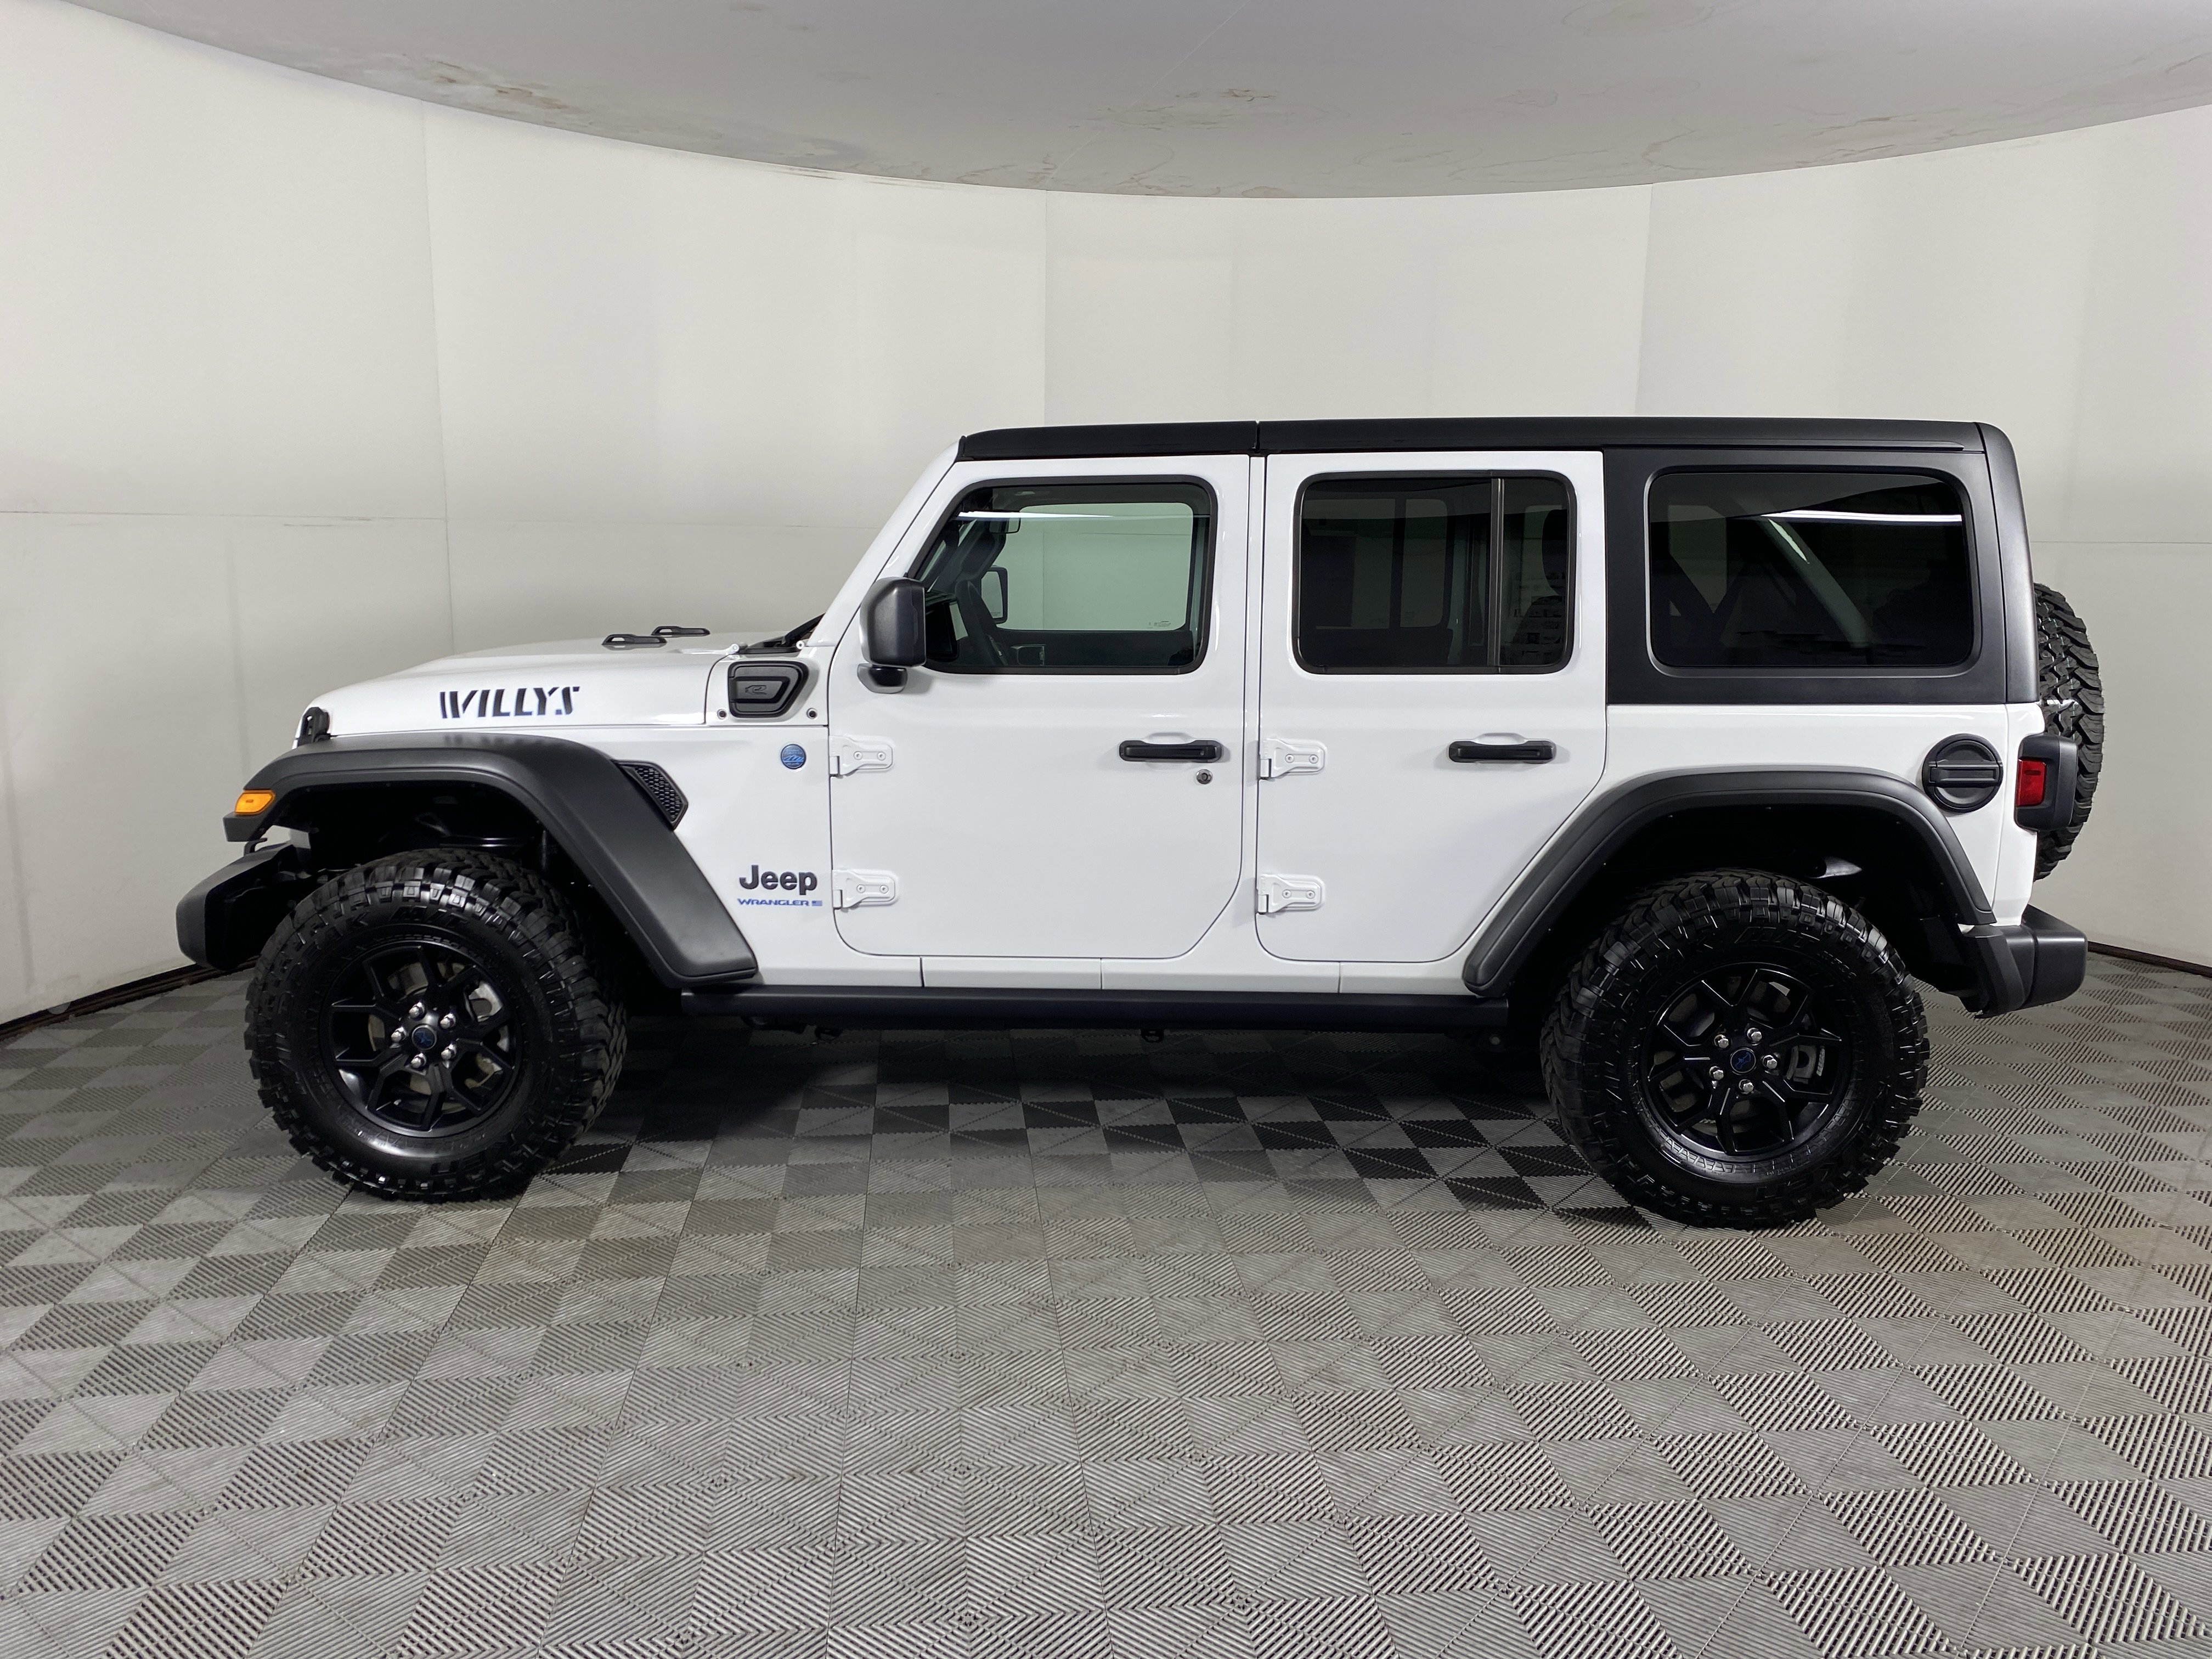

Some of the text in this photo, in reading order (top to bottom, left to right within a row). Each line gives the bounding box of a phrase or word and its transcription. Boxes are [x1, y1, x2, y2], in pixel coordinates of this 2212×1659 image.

[439, 686, 580, 719] WILLYS
[739, 865, 817, 895] Jeep
[737, 898, 810, 906] WRANGLER
